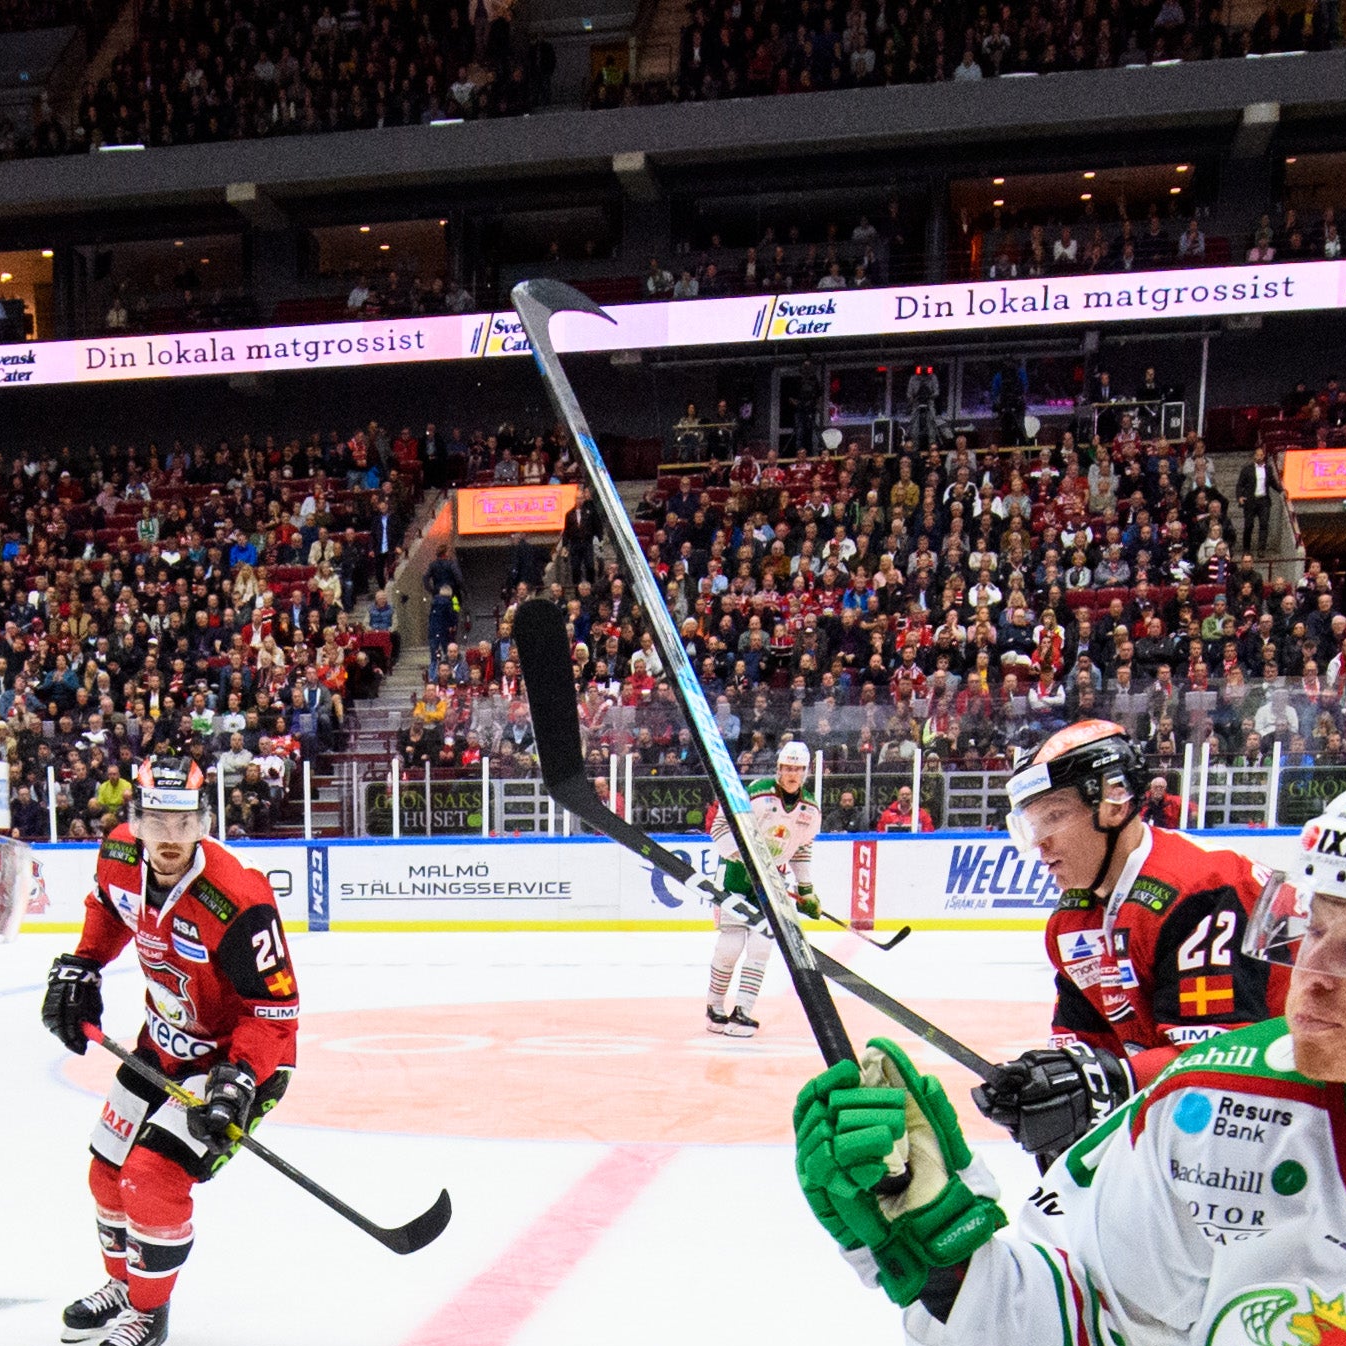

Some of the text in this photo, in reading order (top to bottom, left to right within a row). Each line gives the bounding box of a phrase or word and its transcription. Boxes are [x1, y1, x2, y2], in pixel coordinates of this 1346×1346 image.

[776, 300, 836, 318] Svensk
[895, 275, 1294, 320] Din lokala matgrossist
[494, 320, 524, 334] Sve
[785, 318, 831, 335] Cater
[85, 330, 425, 370] Din lokala matgrossist
[501, 336, 535, 351] Cat
[157, 778, 183, 787] CCM
[310, 850, 325, 915] CCM
[409, 861, 489, 879] MALMÖ
[856, 845, 871, 905] CCM
[341, 879, 572, 896] STÄLLNINGSSERVICE
[173, 917, 199, 939] RSA
[1177, 910, 1237, 971] 22
[253, 919, 285, 972] 21
[1218, 1097, 1293, 1128] Resurs
[1213, 1119, 1265, 1143] Bank
[1170, 1159, 1264, 1195] Backahill
[1188, 1200, 1265, 1227] OTOR
